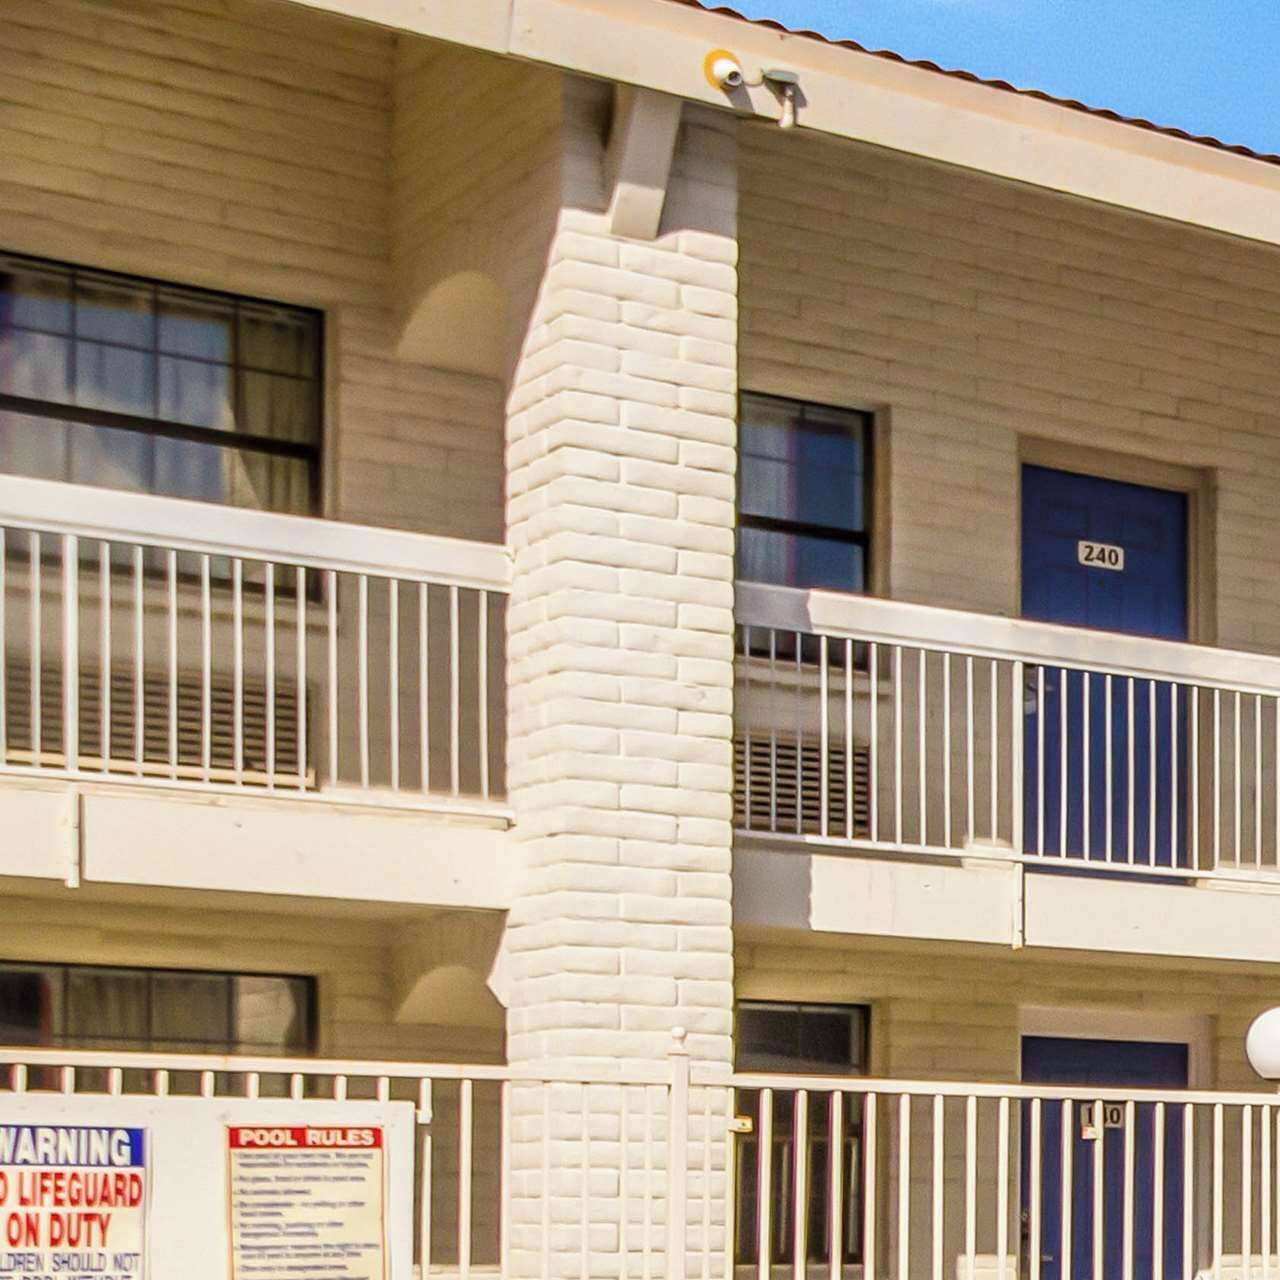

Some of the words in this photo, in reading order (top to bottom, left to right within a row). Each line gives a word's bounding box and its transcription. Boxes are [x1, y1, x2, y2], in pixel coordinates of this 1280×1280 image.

[1083, 545, 1119, 566] 240
[1087, 1106, 1121, 1124] 10
[0, 1127, 131, 1166] WARNING
[239, 1129, 297, 1146] POOL
[305, 1129, 375, 1146] RULES
[19, 1171, 143, 1207] LIFEGUARD
[7, 1212, 39, 1247] ON
[49, 1212, 112, 1247] DUTY
[52, 1252, 106, 1272] SHOULD
[113, 1252, 140, 1272] NOT
